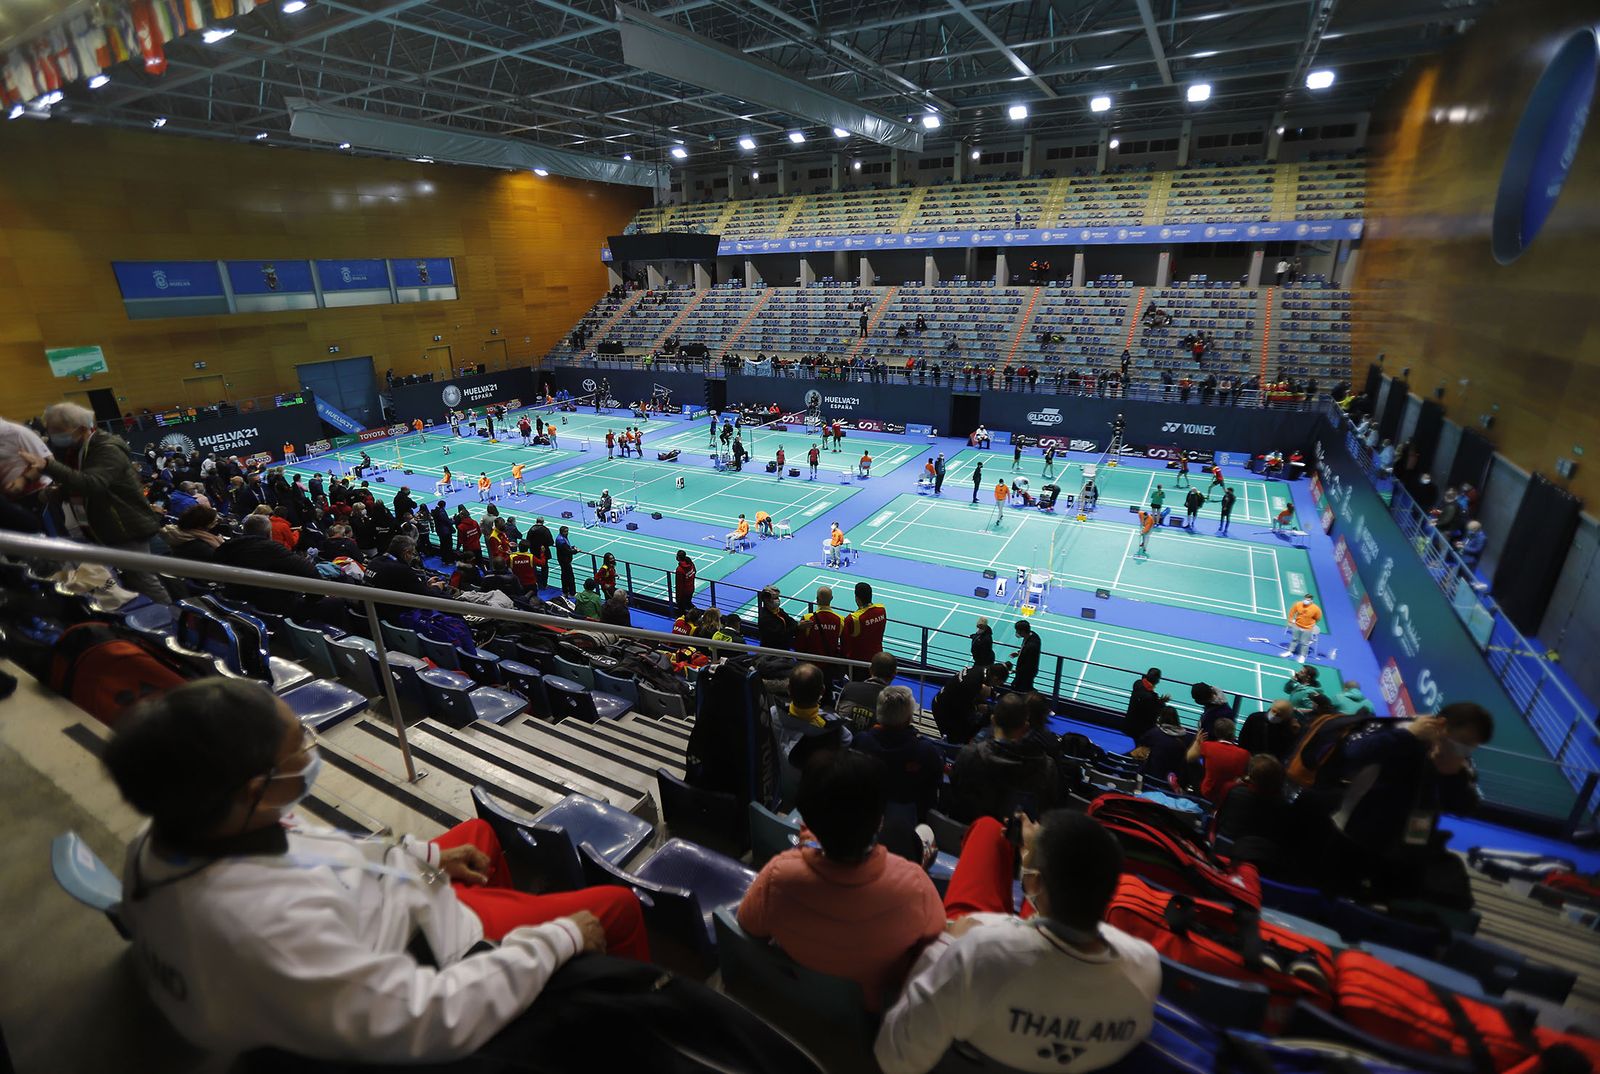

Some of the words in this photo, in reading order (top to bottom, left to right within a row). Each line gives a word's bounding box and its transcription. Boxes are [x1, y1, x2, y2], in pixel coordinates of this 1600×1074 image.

[471, 391, 493, 401] ESPAÑA
[360, 430, 386, 441] TOYOTA
[1183, 423, 1216, 436] YONEX
[212, 438, 251, 453] ESPAÑA
[865, 614, 885, 626] SPAIN
[1009, 1008, 1137, 1042] THAILAND
